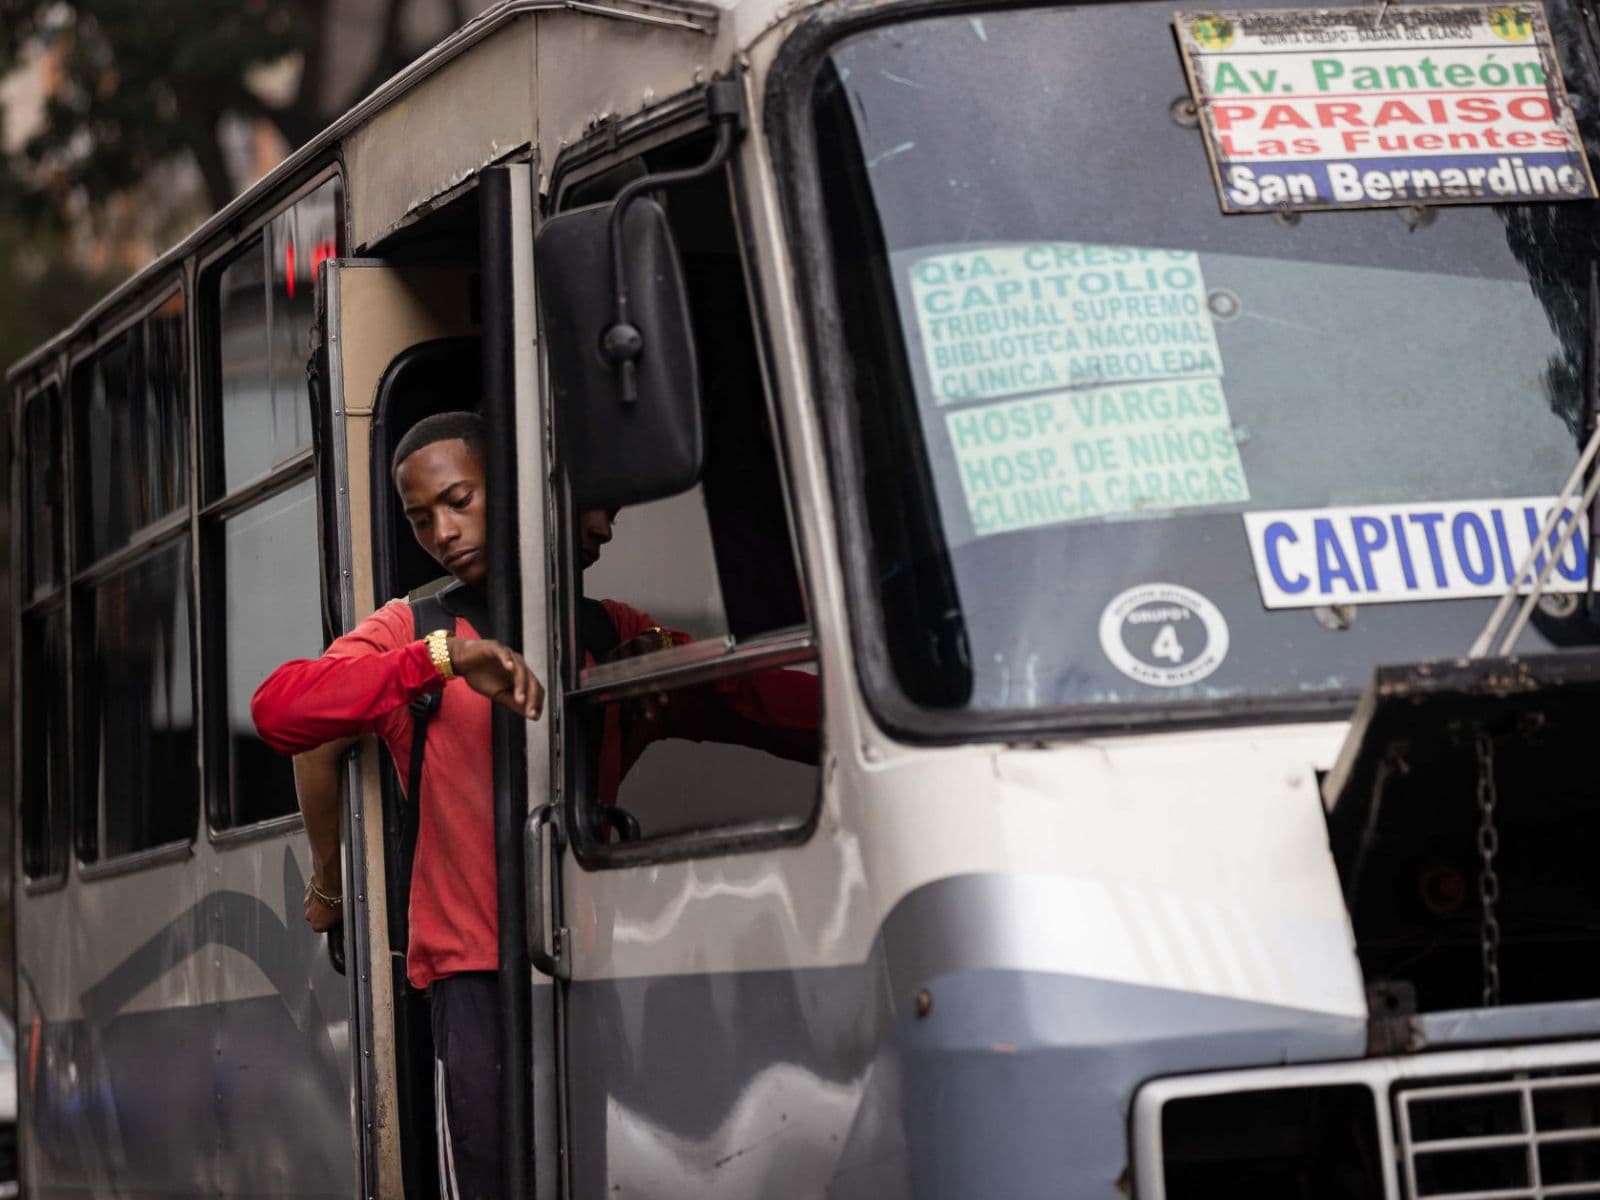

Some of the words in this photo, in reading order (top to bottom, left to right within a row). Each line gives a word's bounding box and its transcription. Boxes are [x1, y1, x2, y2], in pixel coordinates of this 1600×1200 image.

[1214, 61, 1292, 94] Av.
[1312, 54, 1546, 91] Panteón
[1212, 96, 1553, 130] PARAISO
[1221, 136, 1323, 156] Las
[1341, 127, 1569, 153] Fuentes
[1230, 165, 1316, 206] San
[1326, 157, 1586, 202] Bernardino
[923, 267, 1196, 314] CAPITOLIO
[929, 308, 1066, 341] TRIBUNAL
[1072, 294, 1199, 324] SUPREMO
[934, 328, 1080, 371] BIBLIOTECA
[1087, 320, 1210, 355] NACIONAL
[940, 361, 1057, 400] CLINICA
[1069, 349, 1216, 379] ARBOLEDA
[953, 400, 1063, 450] HOSP.
[1068, 383, 1222, 428] VARGAS
[960, 447, 1065, 492] HOSP.
[1072, 438, 1121, 475] DE
[1127, 422, 1236, 463] NIÑOS
[971, 483, 1097, 531] CLINICA
[1103, 465, 1244, 507] CARACAS
[1263, 506, 1590, 595] CAPITOLIO
[1151, 624, 1184, 663] 4
